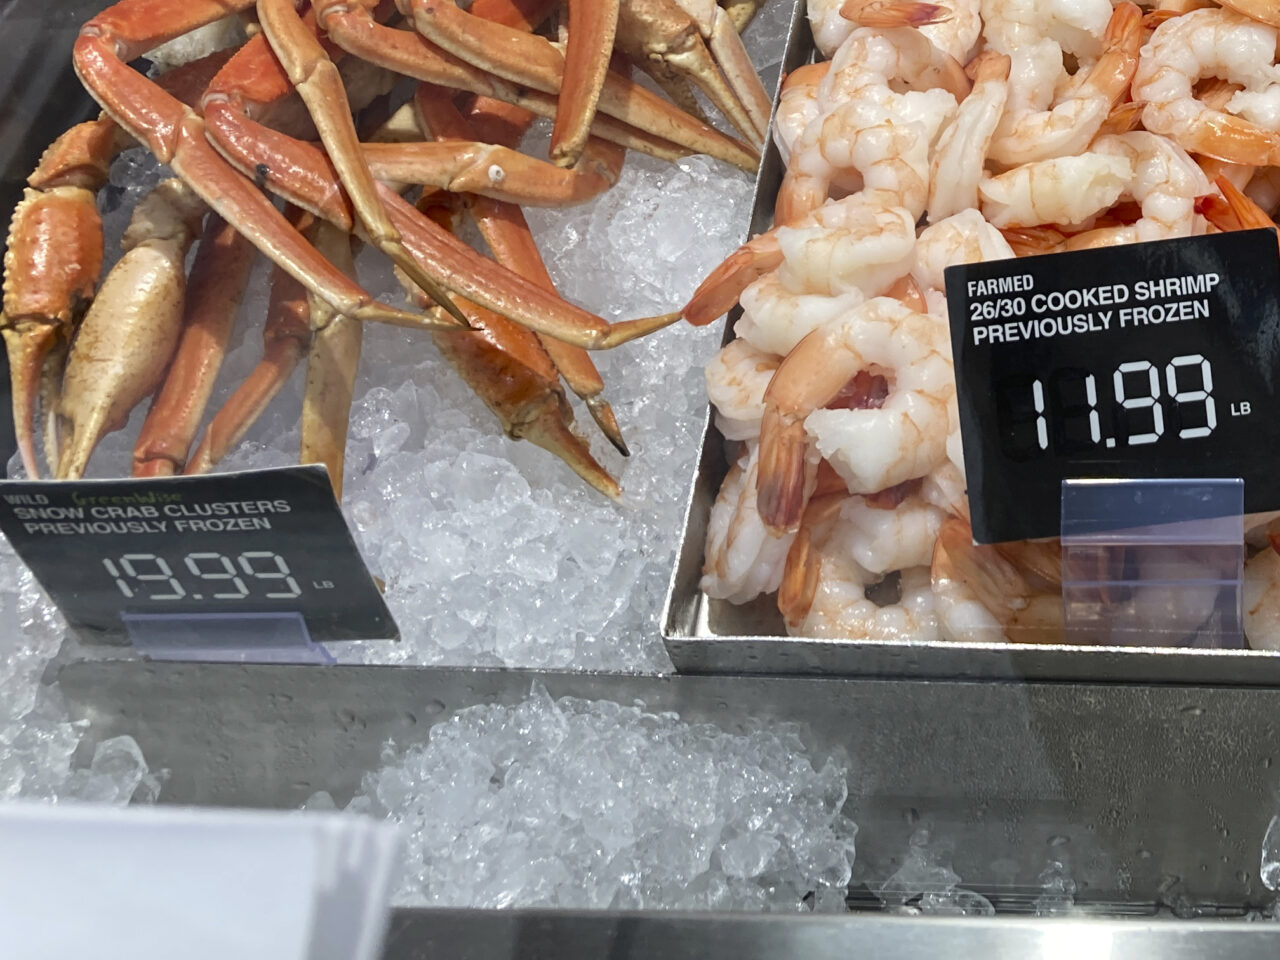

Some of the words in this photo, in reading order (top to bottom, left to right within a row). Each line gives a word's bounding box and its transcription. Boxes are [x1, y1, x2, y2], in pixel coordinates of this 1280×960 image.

[967, 274, 1034, 297] FARMED
[970, 297, 1026, 320] 26/30
[1031, 284, 1129, 313] COOKED
[1135, 273, 1220, 300] SHRIMP
[973, 311, 1112, 345] PREVIOUSLY
[1120, 299, 1210, 327] FROZEN
[1032, 354, 1217, 450] 11.99
[1231, 402, 1251, 416] LB
[3, 494, 49, 505] WILD
[14, 507, 84, 519] SNOW
[90, 505, 159, 518] CRAB
[164, 500, 291, 517] CLUSTERS
[24, 521, 167, 535] PREVIOUSLY
[175, 517, 272, 532] FROZEN
[103, 551, 302, 600] 19.99
[313, 580, 334, 590] LB
